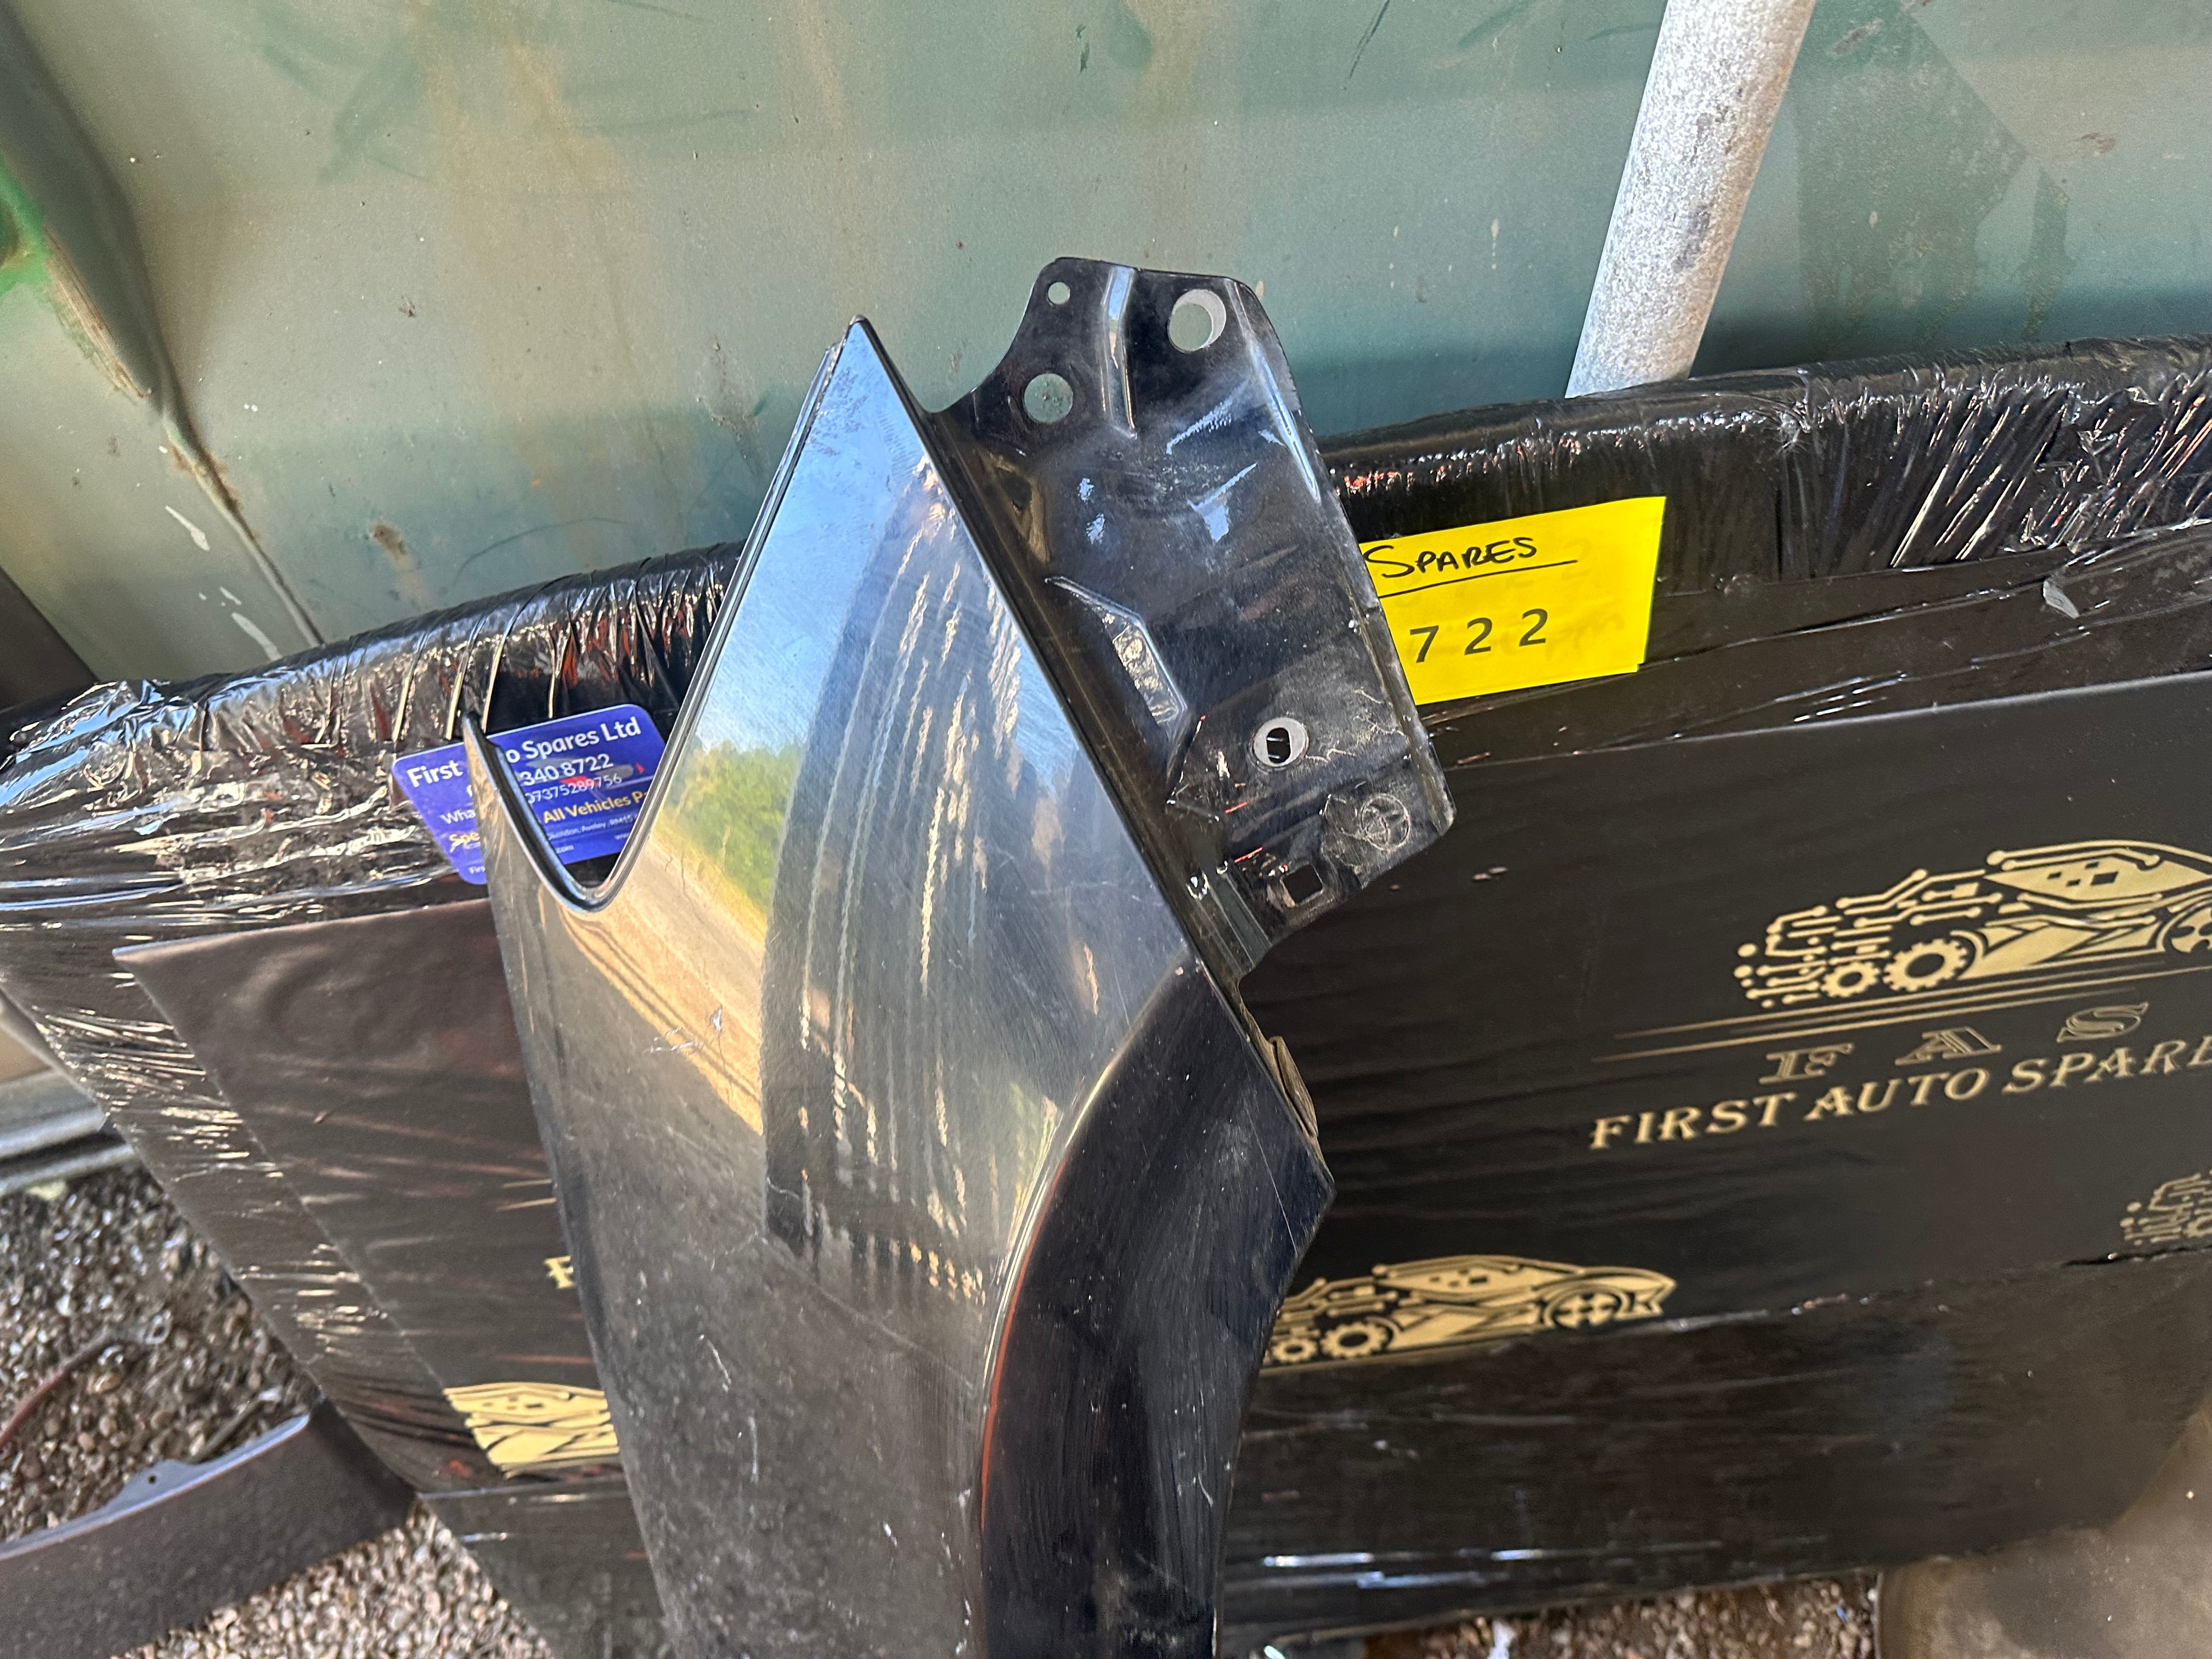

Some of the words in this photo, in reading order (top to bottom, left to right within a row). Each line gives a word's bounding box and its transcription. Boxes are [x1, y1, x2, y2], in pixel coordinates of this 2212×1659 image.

[1362, 537, 1537, 578] SPARES
[407, 760, 464, 788] First
[521, 729, 600, 759] Spares
[600, 716, 642, 742] Ltd
[562, 753, 614, 778] 8722
[543, 807, 566, 823] All
[564, 794, 631, 817] Vehicles
[1590, 1092, 1797, 1150] FIRST
[1803, 1068, 1990, 1121] AUTO
